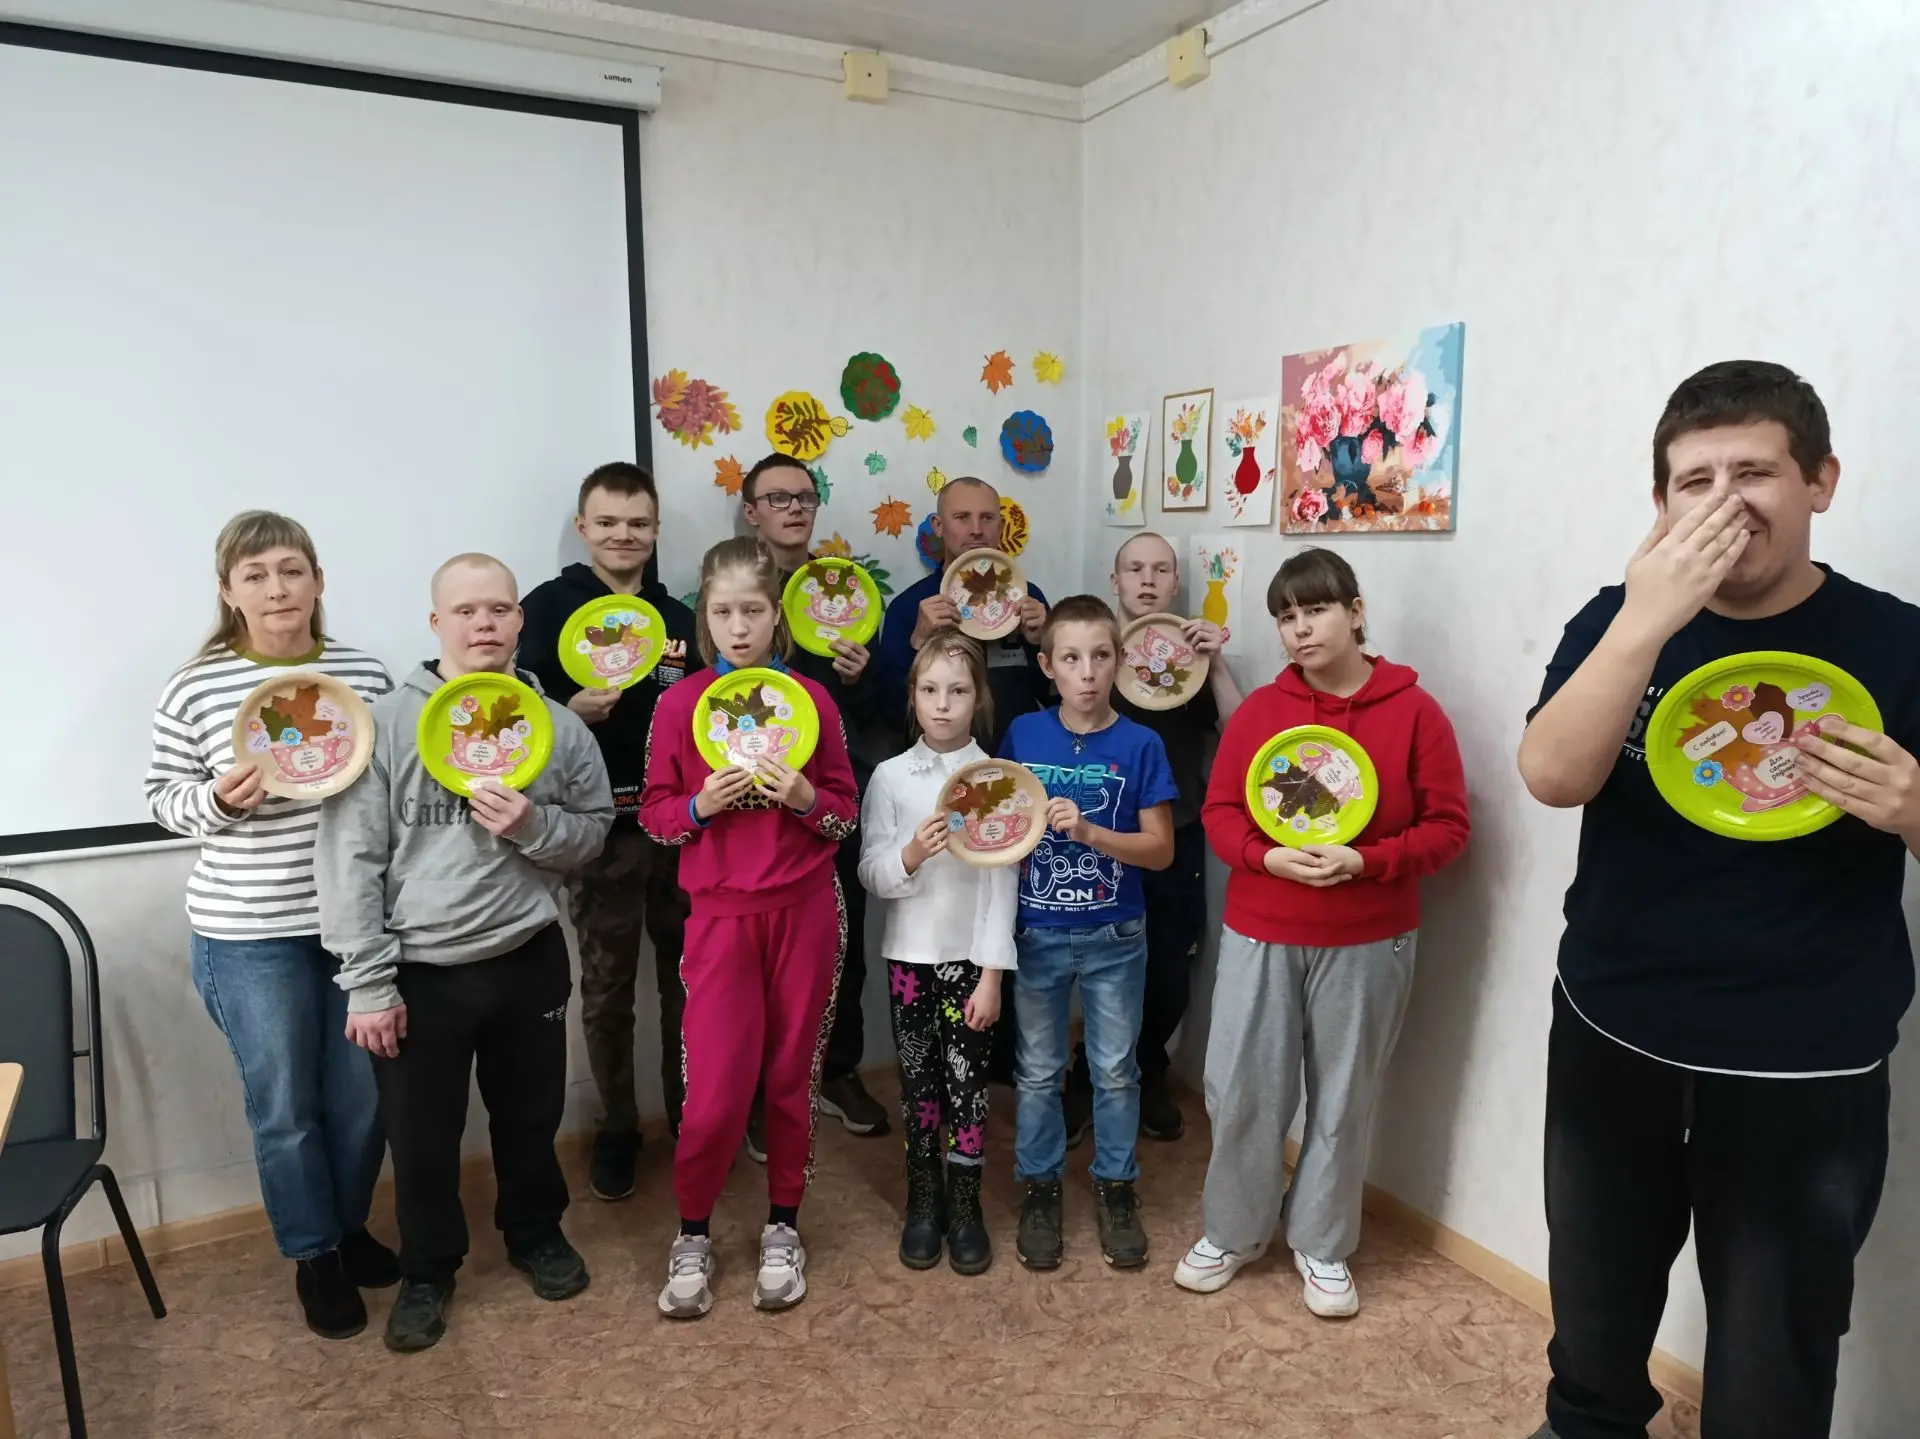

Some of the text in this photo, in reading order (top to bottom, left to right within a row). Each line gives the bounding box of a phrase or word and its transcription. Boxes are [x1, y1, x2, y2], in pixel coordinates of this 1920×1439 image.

[1769, 755, 1783, 766] Для
[1769, 758, 1792, 773] самых
[1056, 888, 1093, 902] ON
